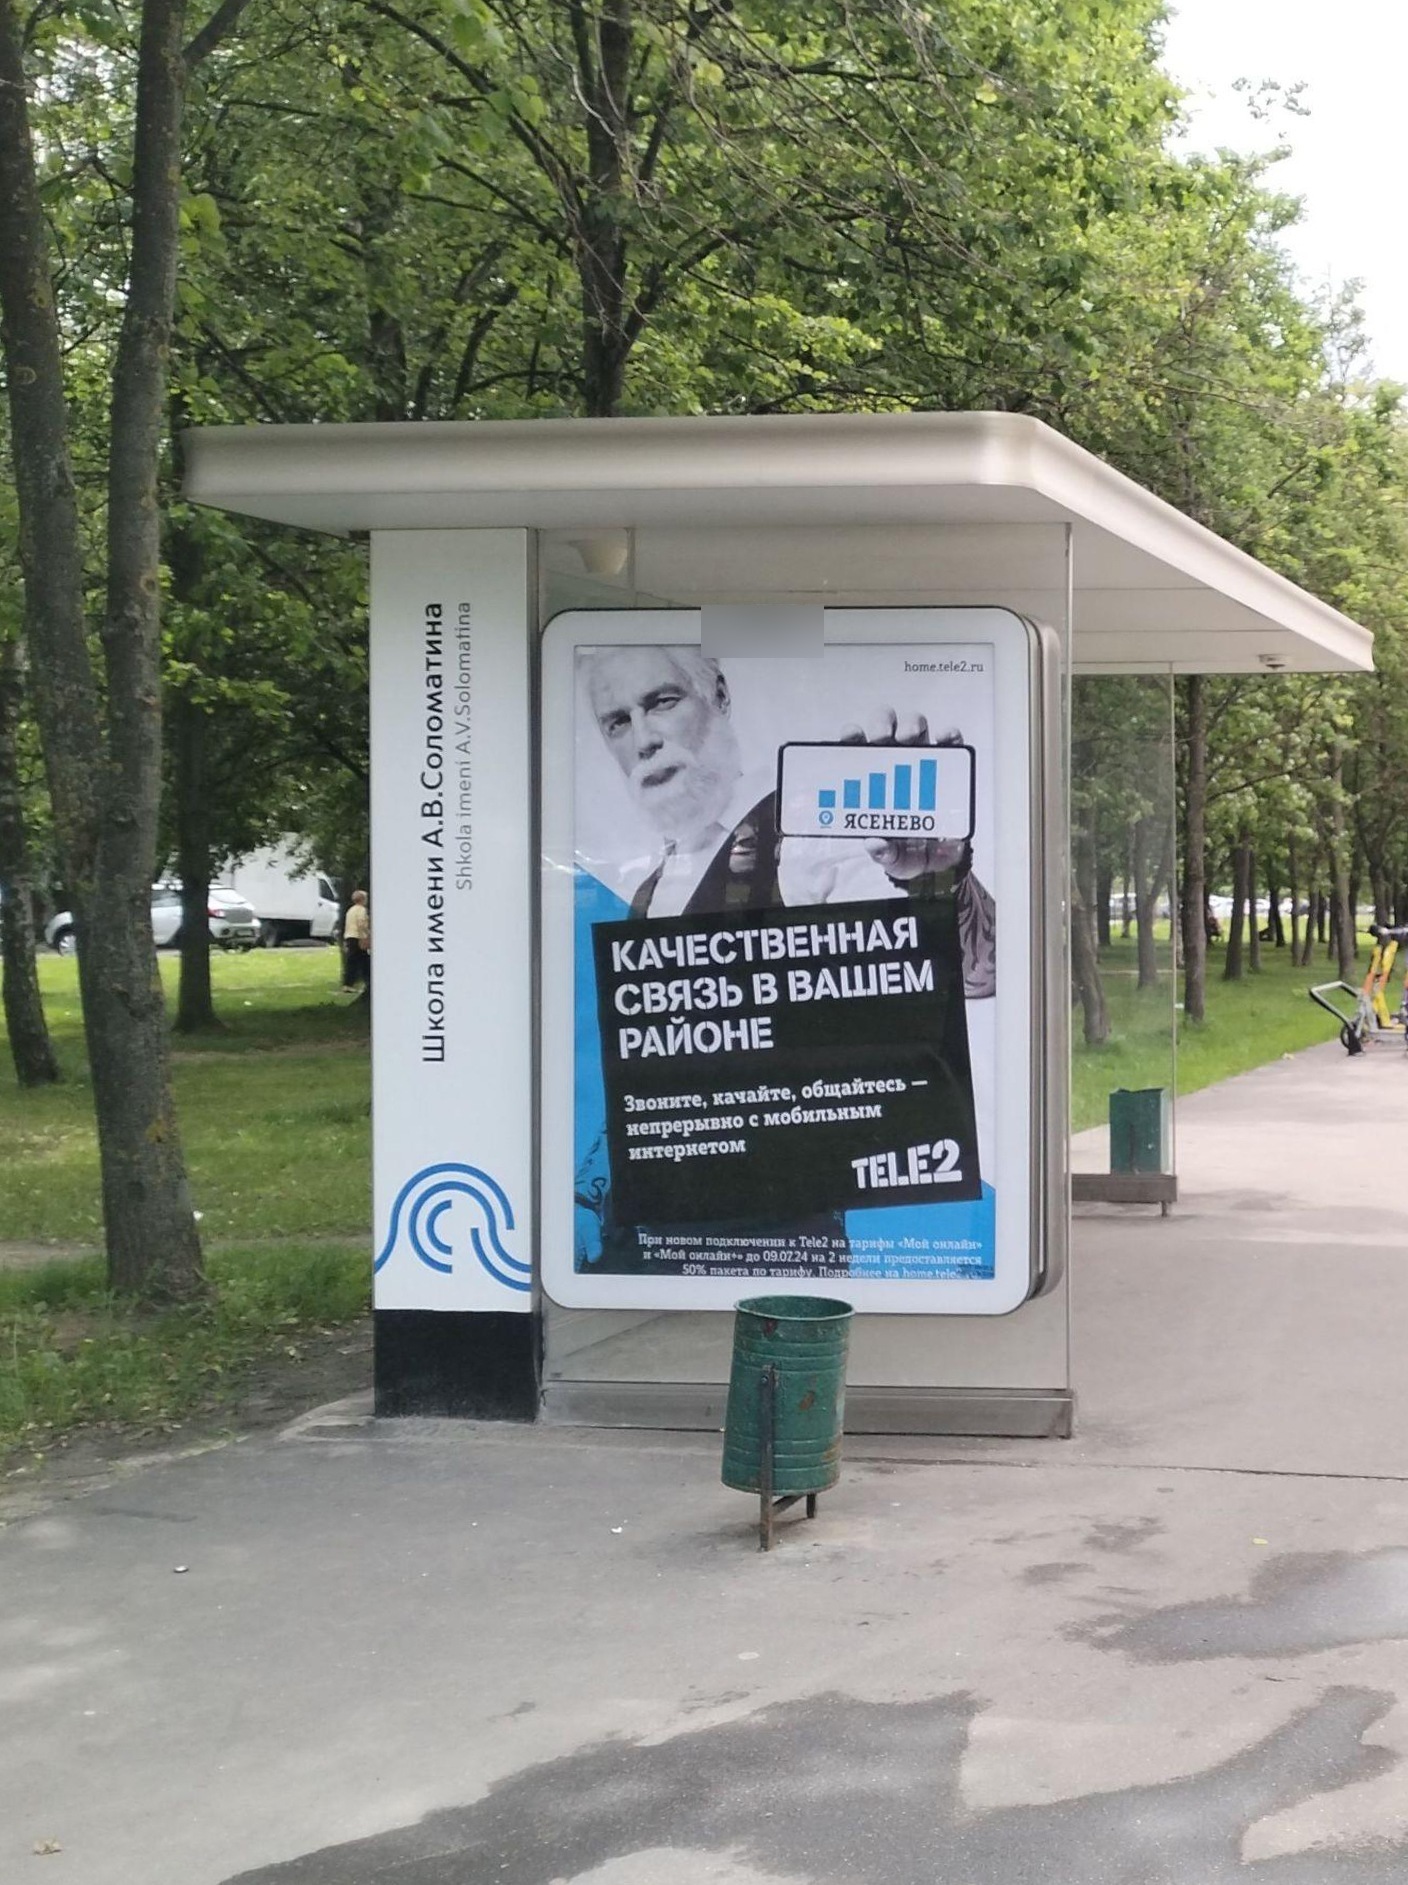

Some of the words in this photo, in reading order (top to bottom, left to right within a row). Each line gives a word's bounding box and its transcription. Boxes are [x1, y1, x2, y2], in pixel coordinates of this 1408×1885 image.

[454, 602, 471, 755] A.V.Solomatina
[904, 660, 984, 673] home.tele2.ru
[421, 603, 443, 847] А.В.Соломатина
[456, 760, 471, 817] imeni
[843, 813, 935, 831] ЯСЕНЕВО
[455, 824, 472, 890] Shkola
[427, 857, 444, 953] имени
[611, 916, 918, 972] КАЧЕСТВЕННАЯ
[614, 976, 743, 1016] СВЯЗЬ
[752, 972, 778, 1005] В
[788, 959, 934, 1002] ВАШЕМ
[422, 963, 444, 1062] Школа
[619, 1016, 774, 1059] РАЙОНЕ
[624, 1094, 707, 1112] Звоните,
[712, 1084, 797, 1107] качайте,
[801, 1078, 906, 1100] общайтесь
[626, 1117, 744, 1137] непрерывно
[749, 1116, 759, 1128] с
[763, 1102, 882, 1127] мобильным
[628, 1139, 746, 1163] интернетом
[851, 1138, 963, 1189] TELE2
[638, 1233, 662, 1247] При
[666, 1235, 702, 1246] новом
[705, 1236, 785, 1248] подключении
[788, 1237, 796, 1247] к
[799, 1235, 828, 1248] Tele2
[831, 1238, 845, 1249] на
[850, 1238, 894, 1251] тарифы
[643, 1250, 651, 1260] и
[653, 1249, 686, 1260] «Мой
[745, 1252, 760, 1262] до
[811, 1252, 826, 1263] на
[828, 1251, 836, 1262] 2
[839, 1252, 880, 1264] недели
[682, 1264, 707, 1275] 50%
[710, 1267, 749, 1276] пакета
[752, 1267, 766, 1277] по
[885, 1269, 899, 1279] на
